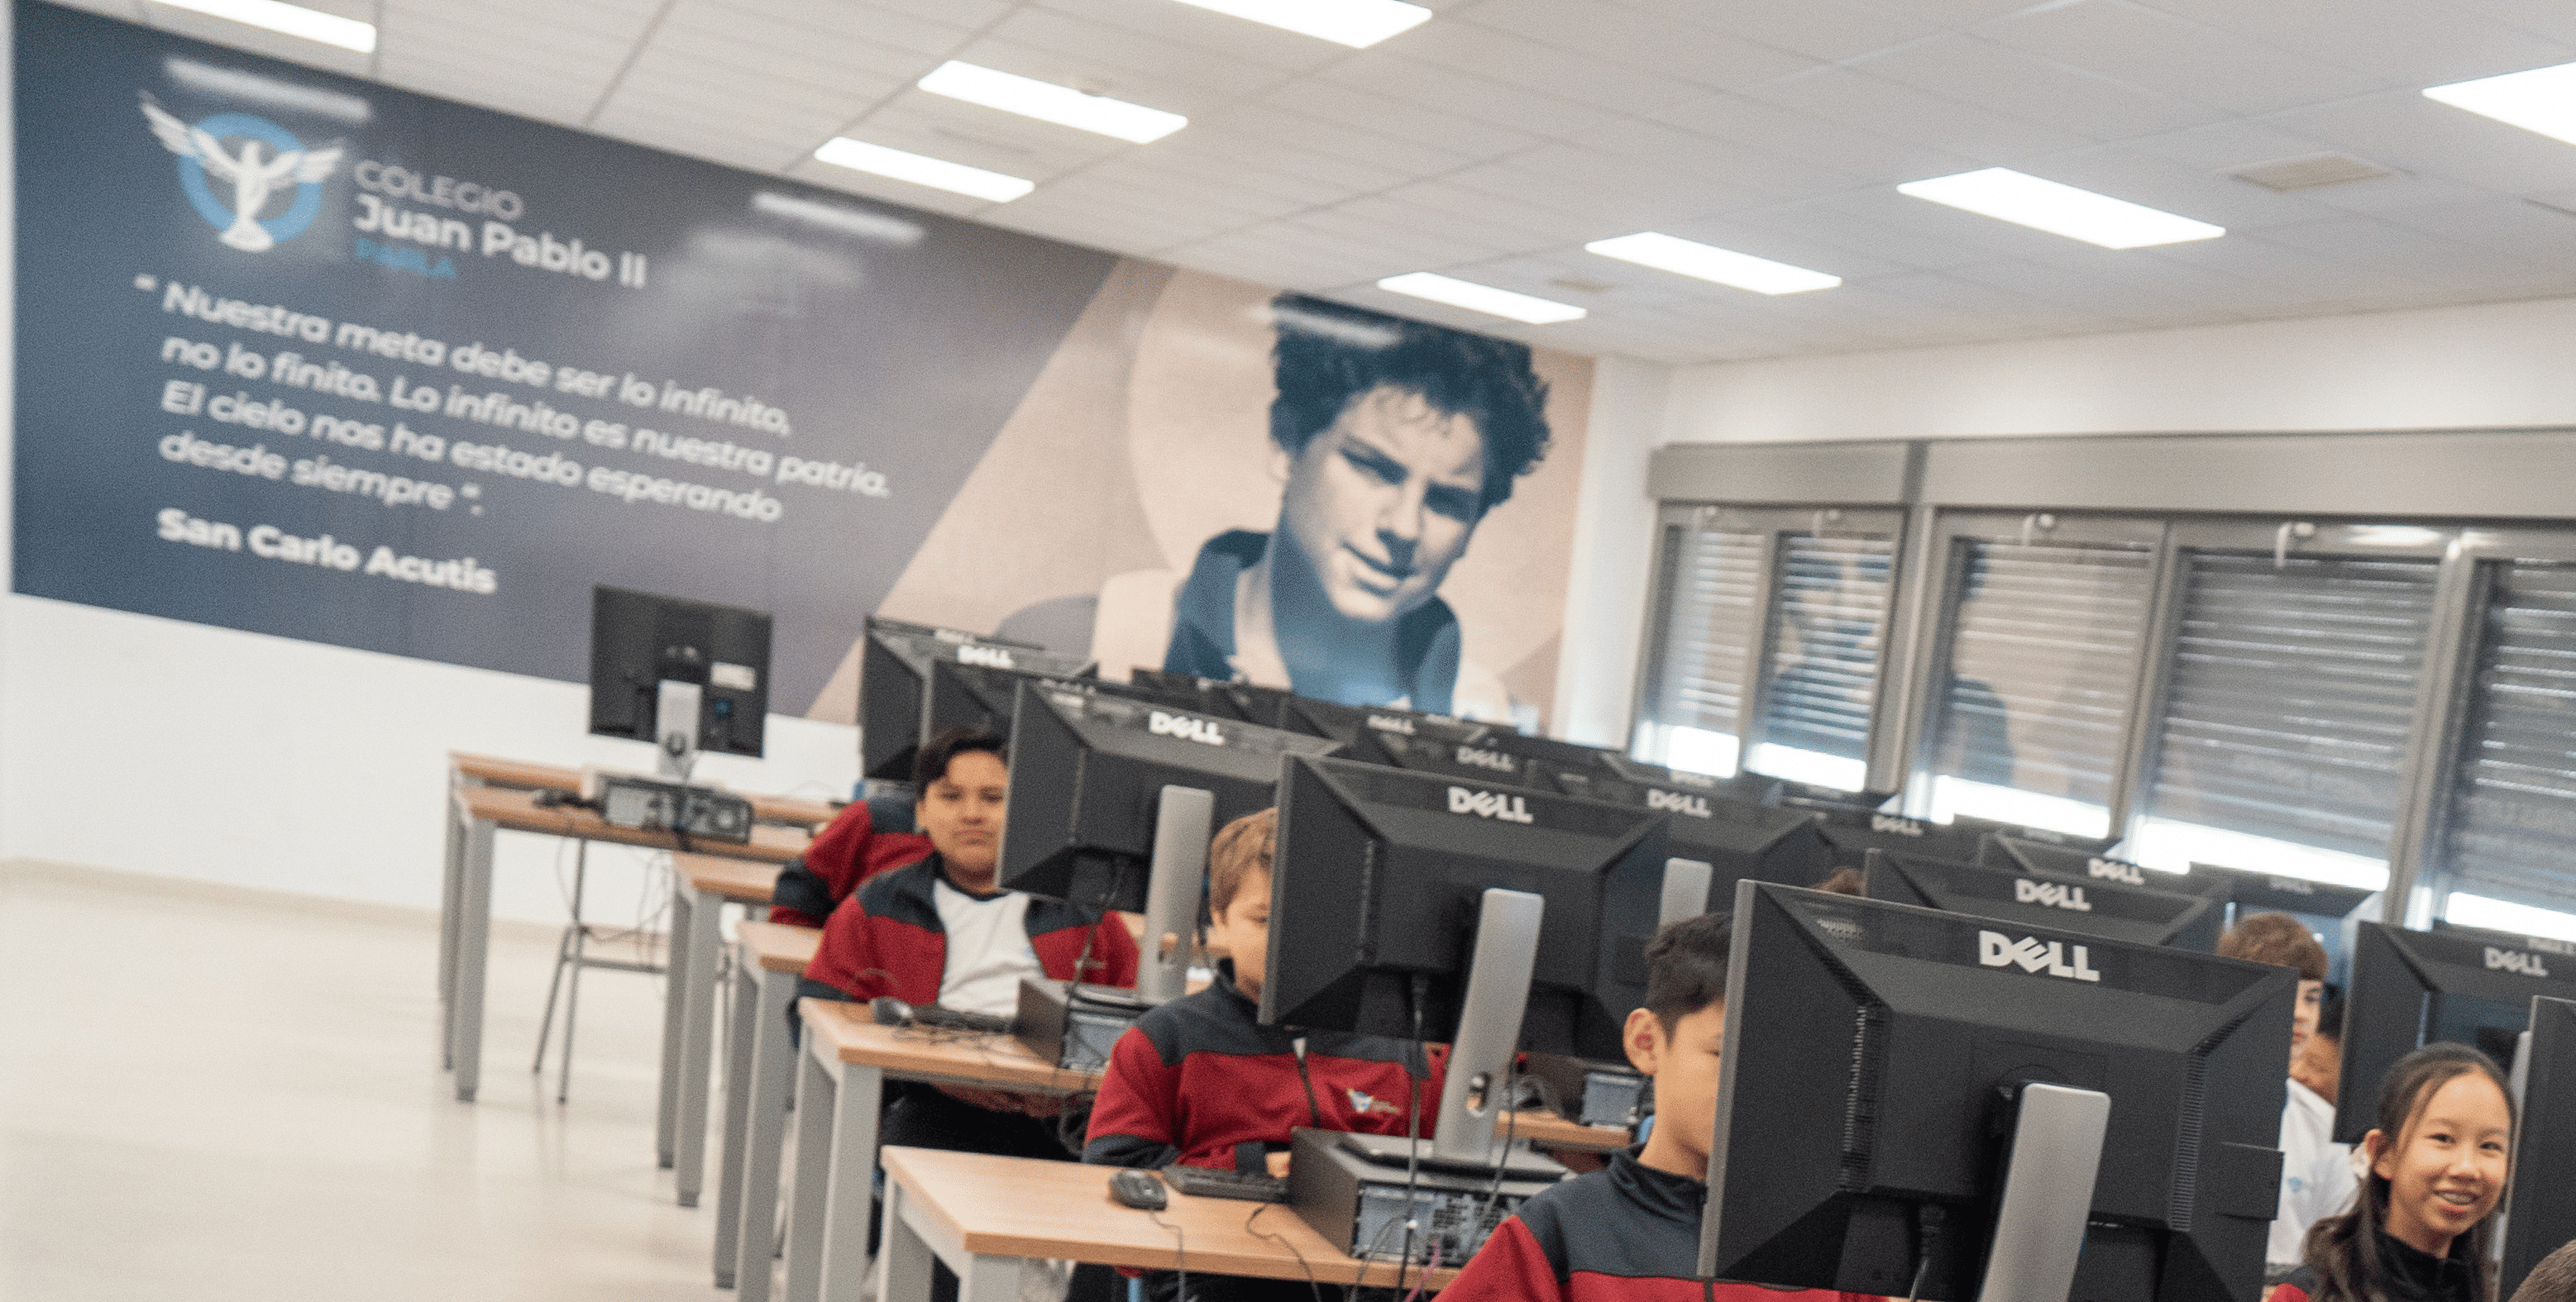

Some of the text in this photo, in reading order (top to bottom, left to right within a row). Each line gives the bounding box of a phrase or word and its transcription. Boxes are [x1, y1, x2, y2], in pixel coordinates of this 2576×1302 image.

[353, 160, 524, 221] COLEGIO
[353, 193, 648, 289] Juan Pablo II
[163, 281, 331, 342] Nuestra
[336, 321, 447, 366] meta
[449, 341, 552, 387] debe
[555, 365, 617, 398] ser
[619, 371, 656, 407] lo
[660, 379, 791, 438] infinito,
[162, 336, 222, 370] no
[225, 341, 266, 379] lo
[390, 375, 441, 413] Lo
[445, 384, 580, 440] infinito
[583, 418, 628, 449] es
[630, 427, 774, 477] nuestra
[775, 455, 891, 498] patria.
[159, 429, 288, 480] desde
[291, 454, 455, 510] siempre
[161, 379, 784, 523] El cielo nos ha estado esperando
[157, 508, 498, 595] San Carlo Acutis
[1149, 711, 1225, 745] DELL
[1456, 746, 1517, 772] DELL
[1448, 785, 1533, 824] DELL
[1647, 788, 1712, 818] DELL
[2014, 878, 2092, 911] DELL
[2088, 857, 2145, 886] DELL
[1978, 929, 2101, 982] DELL
[2484, 947, 2549, 977] DELL
